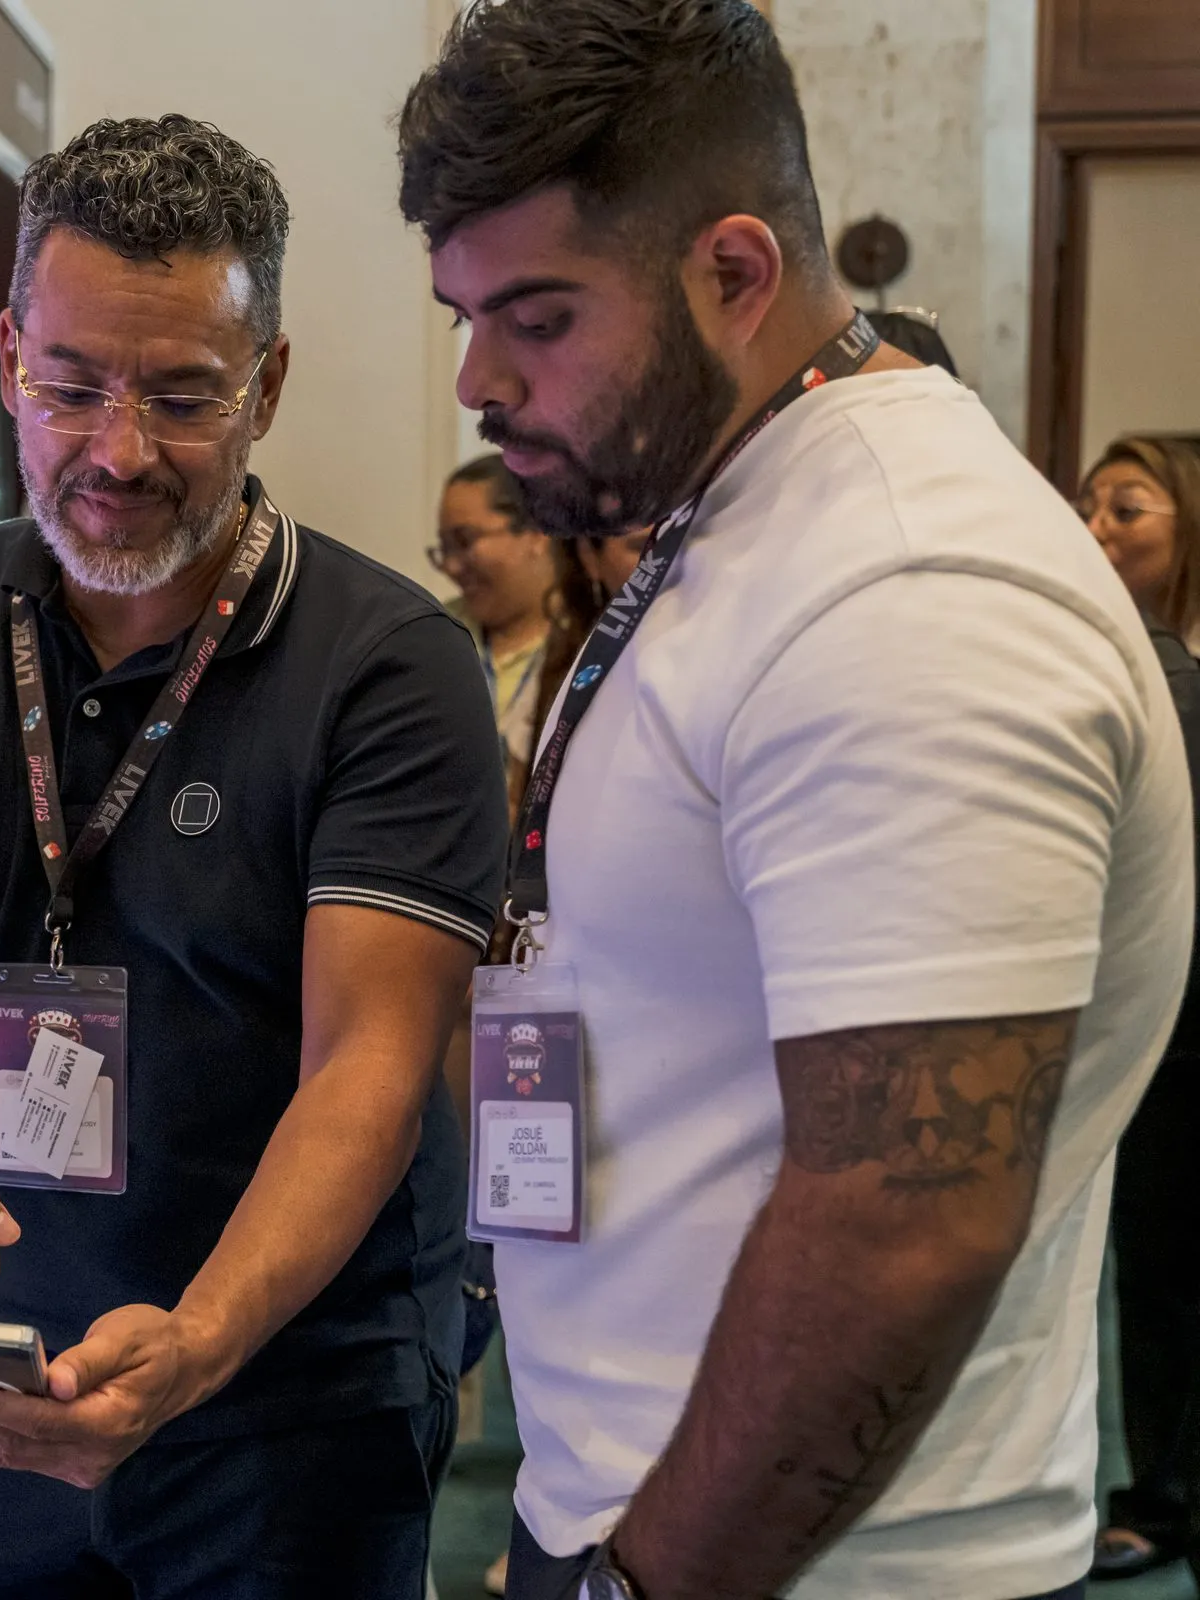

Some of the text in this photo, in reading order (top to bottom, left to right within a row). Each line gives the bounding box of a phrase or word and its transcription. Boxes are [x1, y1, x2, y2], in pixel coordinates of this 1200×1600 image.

[233, 520, 274, 580] LIVEK
[597, 549, 665, 639] LIVEK
[12, 619, 35, 686] LIVEK
[175, 635, 217, 704] SOLFERINO
[28, 755, 51, 822] SOLFERINO
[93, 763, 147, 836] LIVEK
[56, 1048, 79, 1090] LIVEK
[511, 1124, 543, 1141] JOSUÉ
